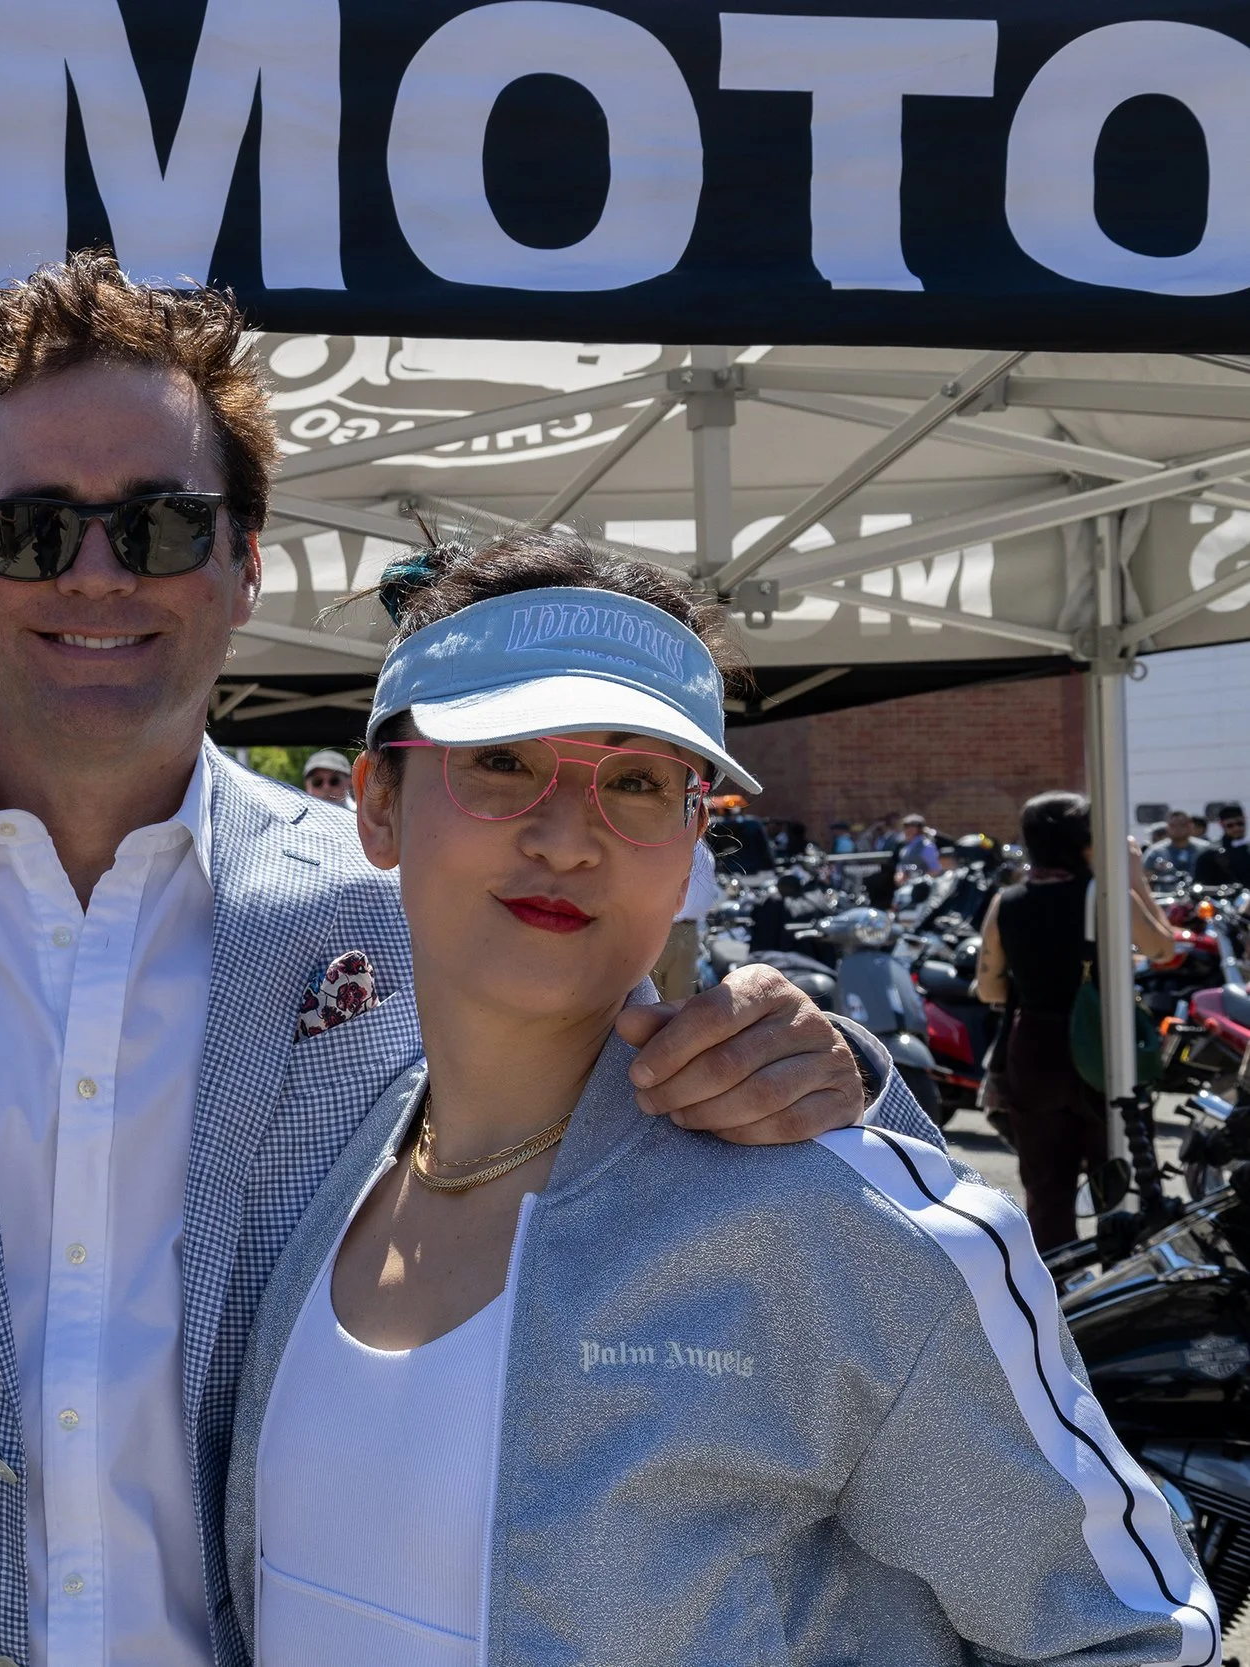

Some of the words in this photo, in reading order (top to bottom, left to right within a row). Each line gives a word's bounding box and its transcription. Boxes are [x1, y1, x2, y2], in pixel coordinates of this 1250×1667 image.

[505, 604, 684, 682] MOTOWORKS
[579, 1339, 656, 1373] Palm
[664, 1338, 754, 1378] Angels
